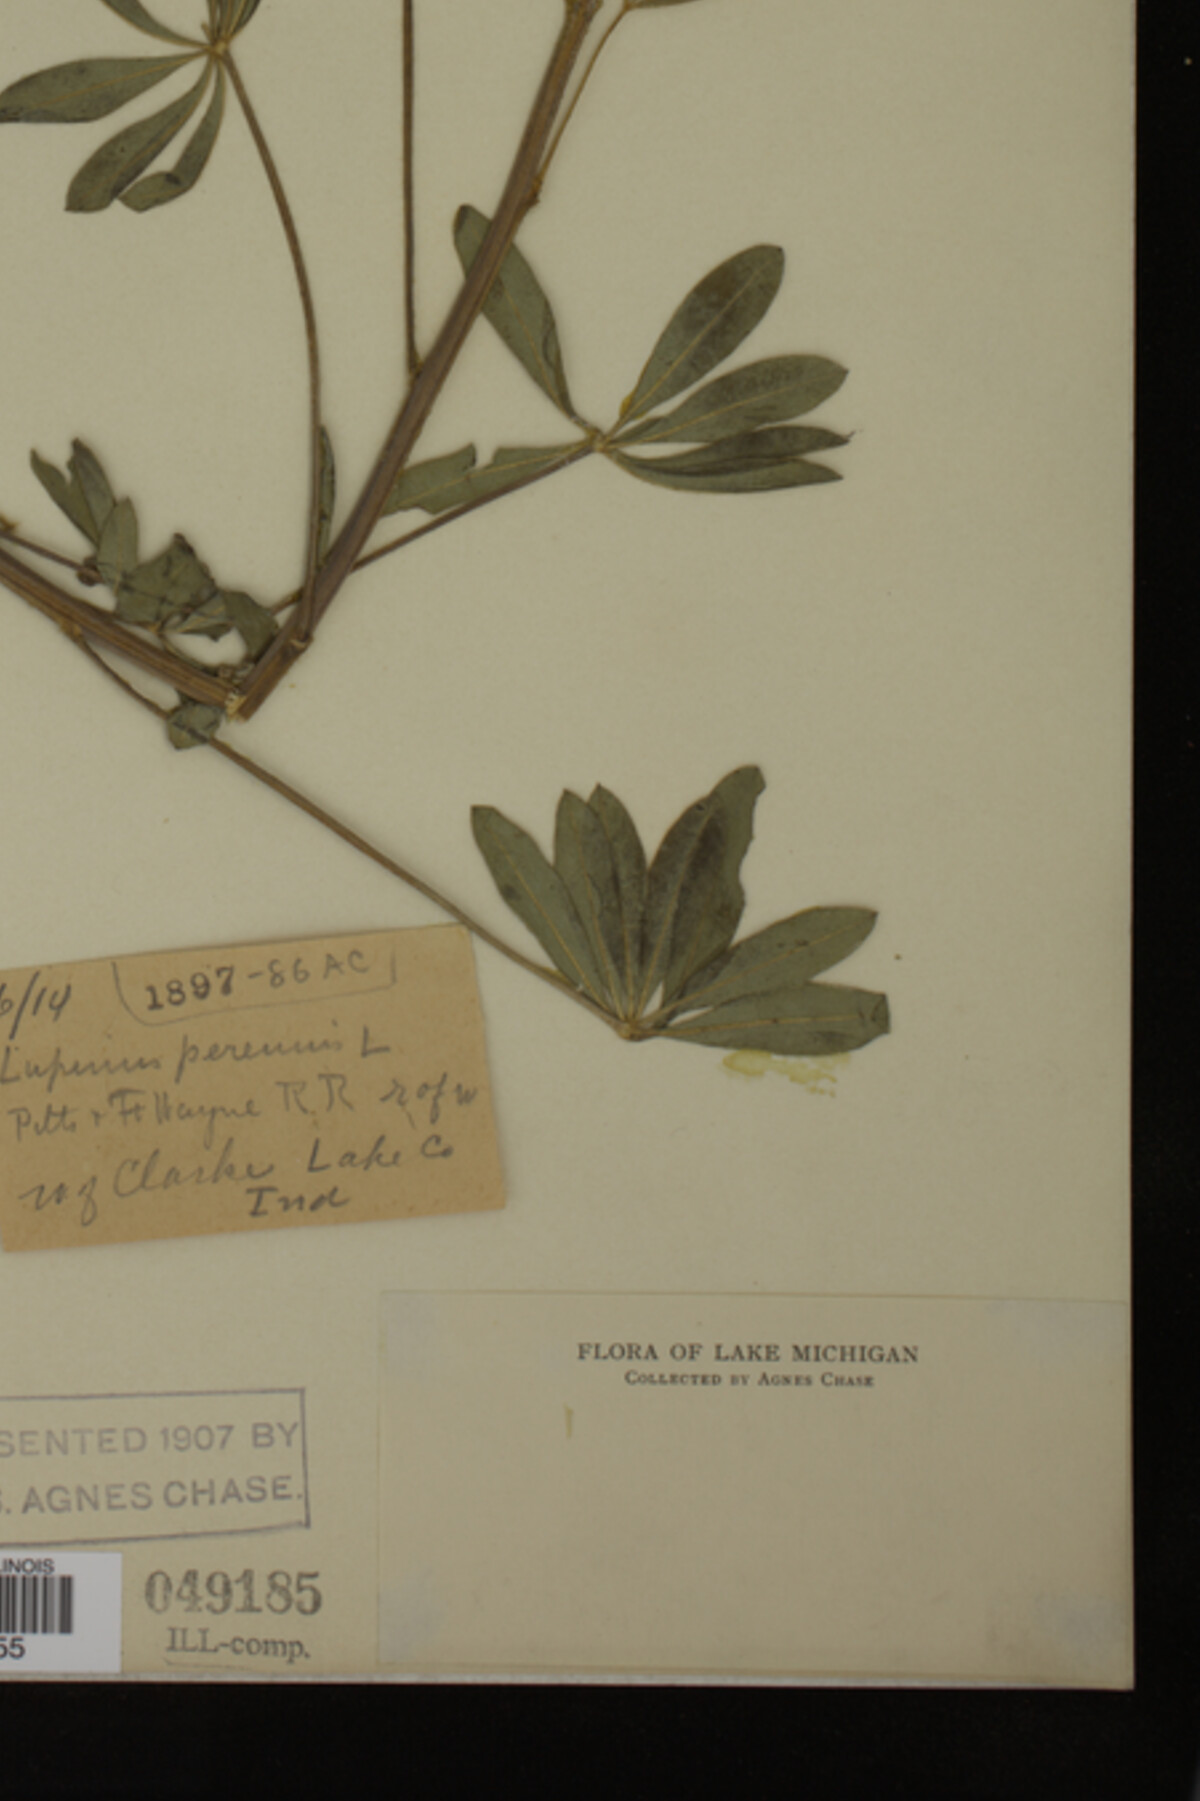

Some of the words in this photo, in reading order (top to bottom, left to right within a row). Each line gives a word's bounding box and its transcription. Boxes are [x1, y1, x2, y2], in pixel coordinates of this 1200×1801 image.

[306, 1134, 402, 1173] Lake
[245, 1186, 351, 1218] Ind
[577, 1342, 658, 1361] FLORA
[669, 1343, 703, 1362] OF
[714, 1344, 780, 1362] LAKE
[792, 1345, 920, 1364] MICHIGAN
[159, 1425, 235, 1452] 1907
[250, 1421, 301, 1449] BY
[21, 1482, 153, 1516] AGNES
[162, 1475, 304, 1508] CHASE.
[144, 1568, 323, 1615] 049185
[166, 1627, 311, 1664] ILL-comp.
